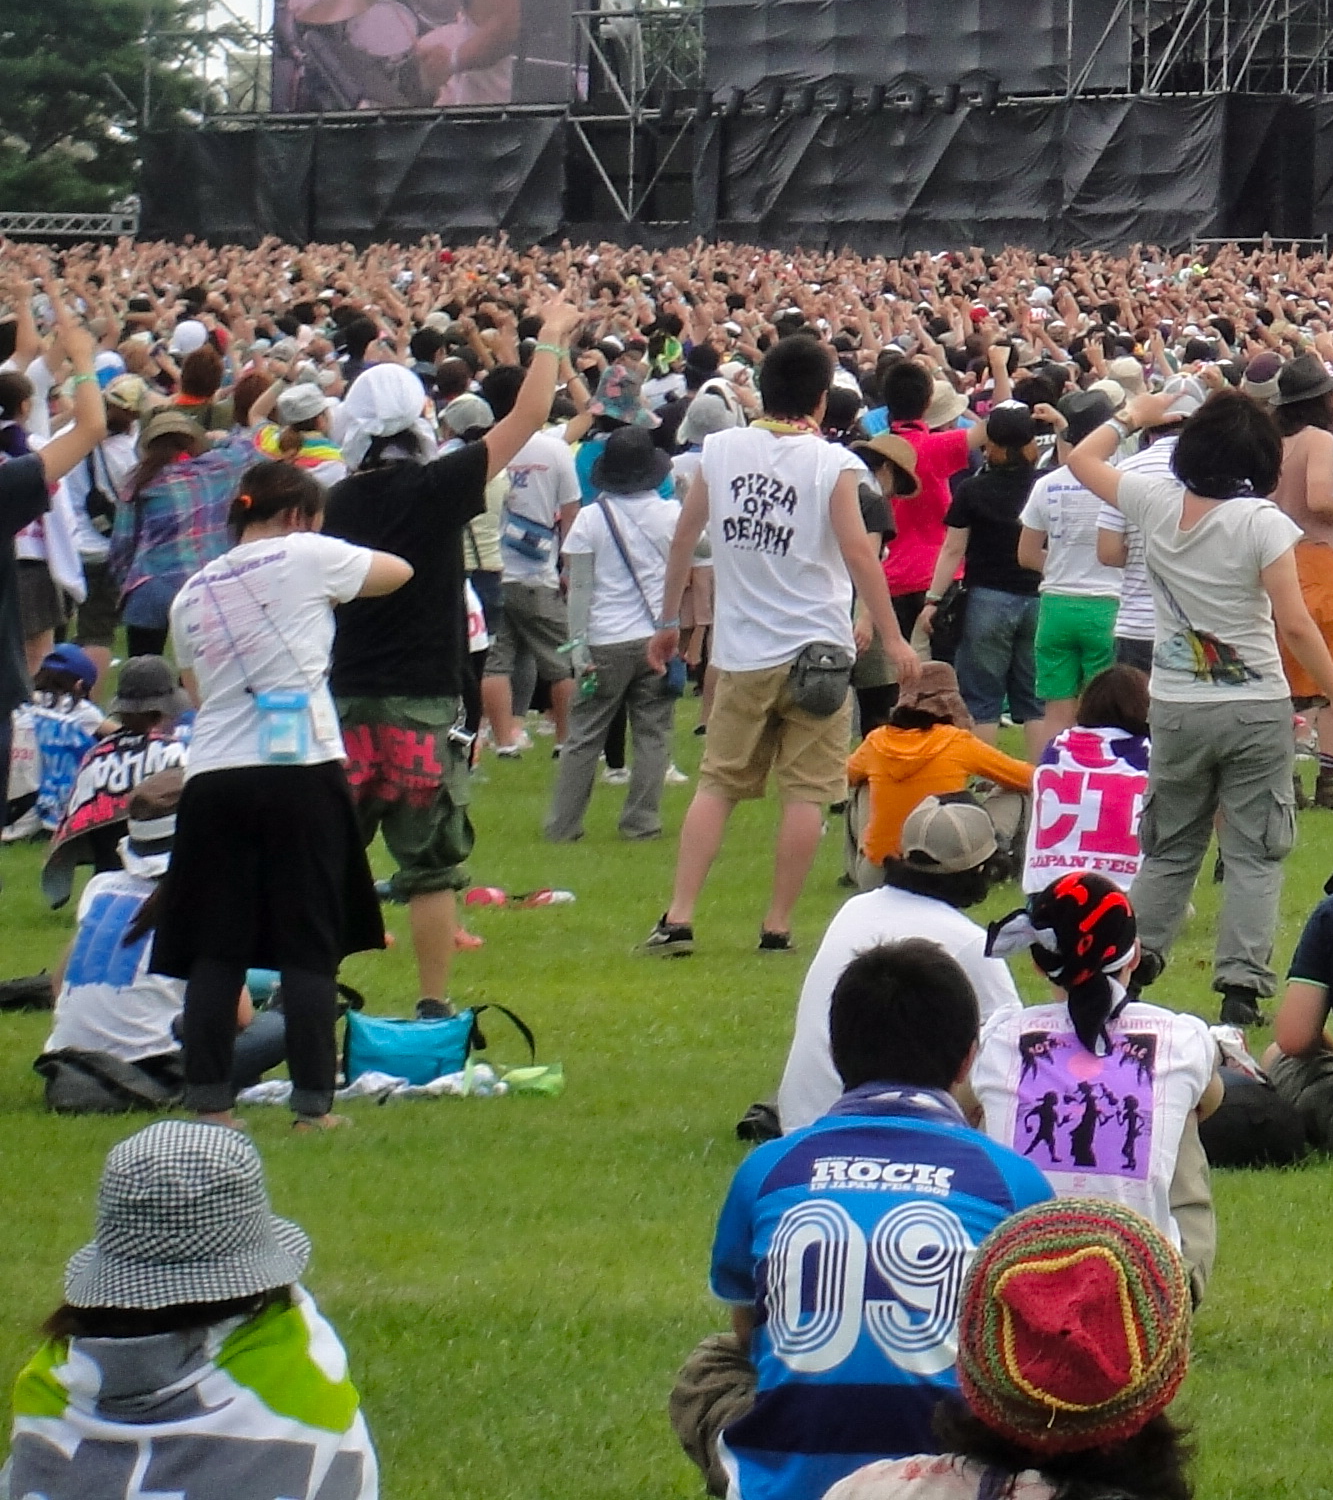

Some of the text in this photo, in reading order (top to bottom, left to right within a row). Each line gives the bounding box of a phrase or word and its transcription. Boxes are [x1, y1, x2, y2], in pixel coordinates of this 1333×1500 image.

[722, 516, 795, 557] DEATH
[811, 1160, 955, 1189] ROCK
[829, 1181, 880, 1190] JAPAN
[765, 1199, 976, 1375] 09
